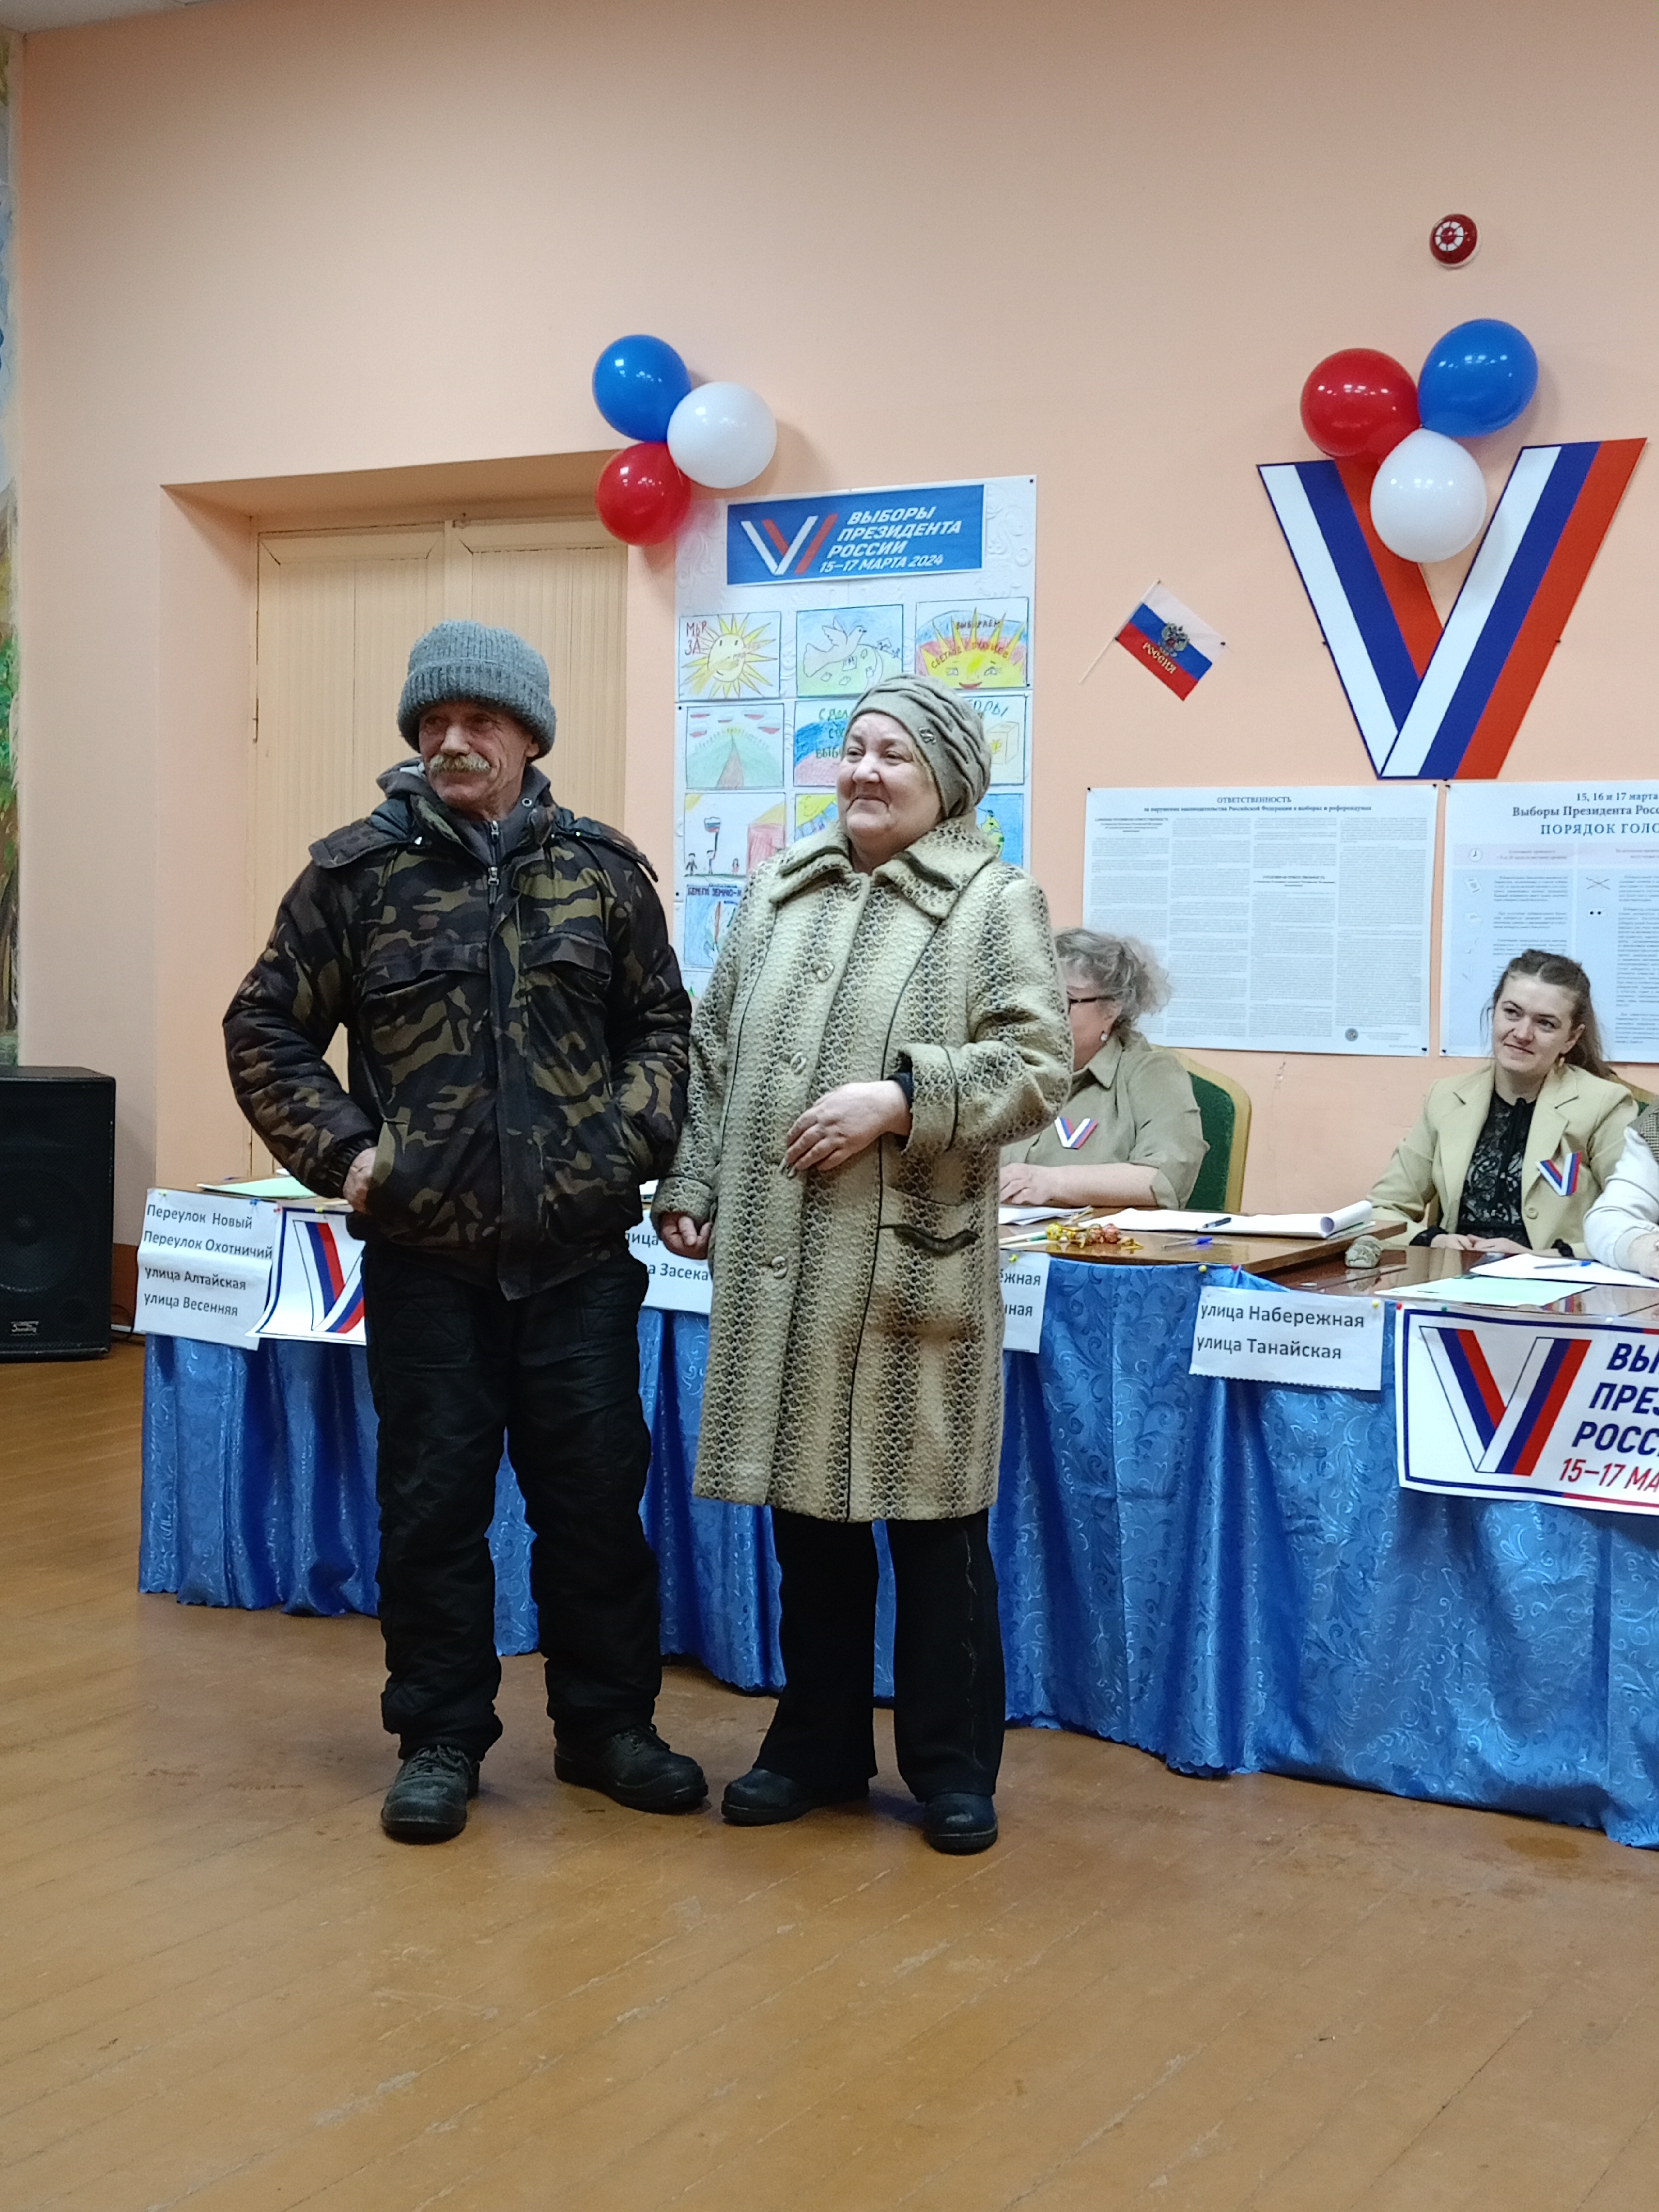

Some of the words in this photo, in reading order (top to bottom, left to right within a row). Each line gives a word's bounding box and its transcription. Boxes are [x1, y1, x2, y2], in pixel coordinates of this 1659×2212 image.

[847, 507, 936, 525] ВЫБОРЫ
[837, 520, 962, 542] ПРЕЗИДЕНТА
[827, 541, 908, 558] РОССИИ
[858, 556, 907, 571] МАРТА
[908, 554, 943, 568] 2024
[1142, 642, 1177, 675] РОССИЯ
[968, 699, 1008, 717] ОРЫ
[1577, 793, 1590, 802] 15,
[1593, 793, 1604, 801] 16
[1616, 792, 1627, 801] 17
[1628, 793, 1659, 802] марта
[1513, 806, 1560, 819] Выборы
[1563, 805, 1631, 818] Президента
[1541, 823, 1615, 836] ПОРЯДОК
[146, 1205, 206, 1223] Переулок
[212, 1211, 253, 1229] Новый
[144, 1231, 202, 1250] Переулок
[205, 1239, 273, 1259] Охотничий
[144, 1266, 181, 1282] улица
[184, 1271, 247, 1290] Алтайская
[660, 1263, 708, 1281] Засека
[144, 1293, 179, 1309] улица
[183, 1298, 238, 1316] Весенняя
[1201, 1305, 1243, 1321] улица
[1249, 1305, 1364, 1327] Набережная
[1197, 1336, 1241, 1354] улица
[1247, 1338, 1342, 1360] Танайская
[1589, 1382, 1659, 1416] ПРЕ
[1571, 1421, 1659, 1457] РОСС
